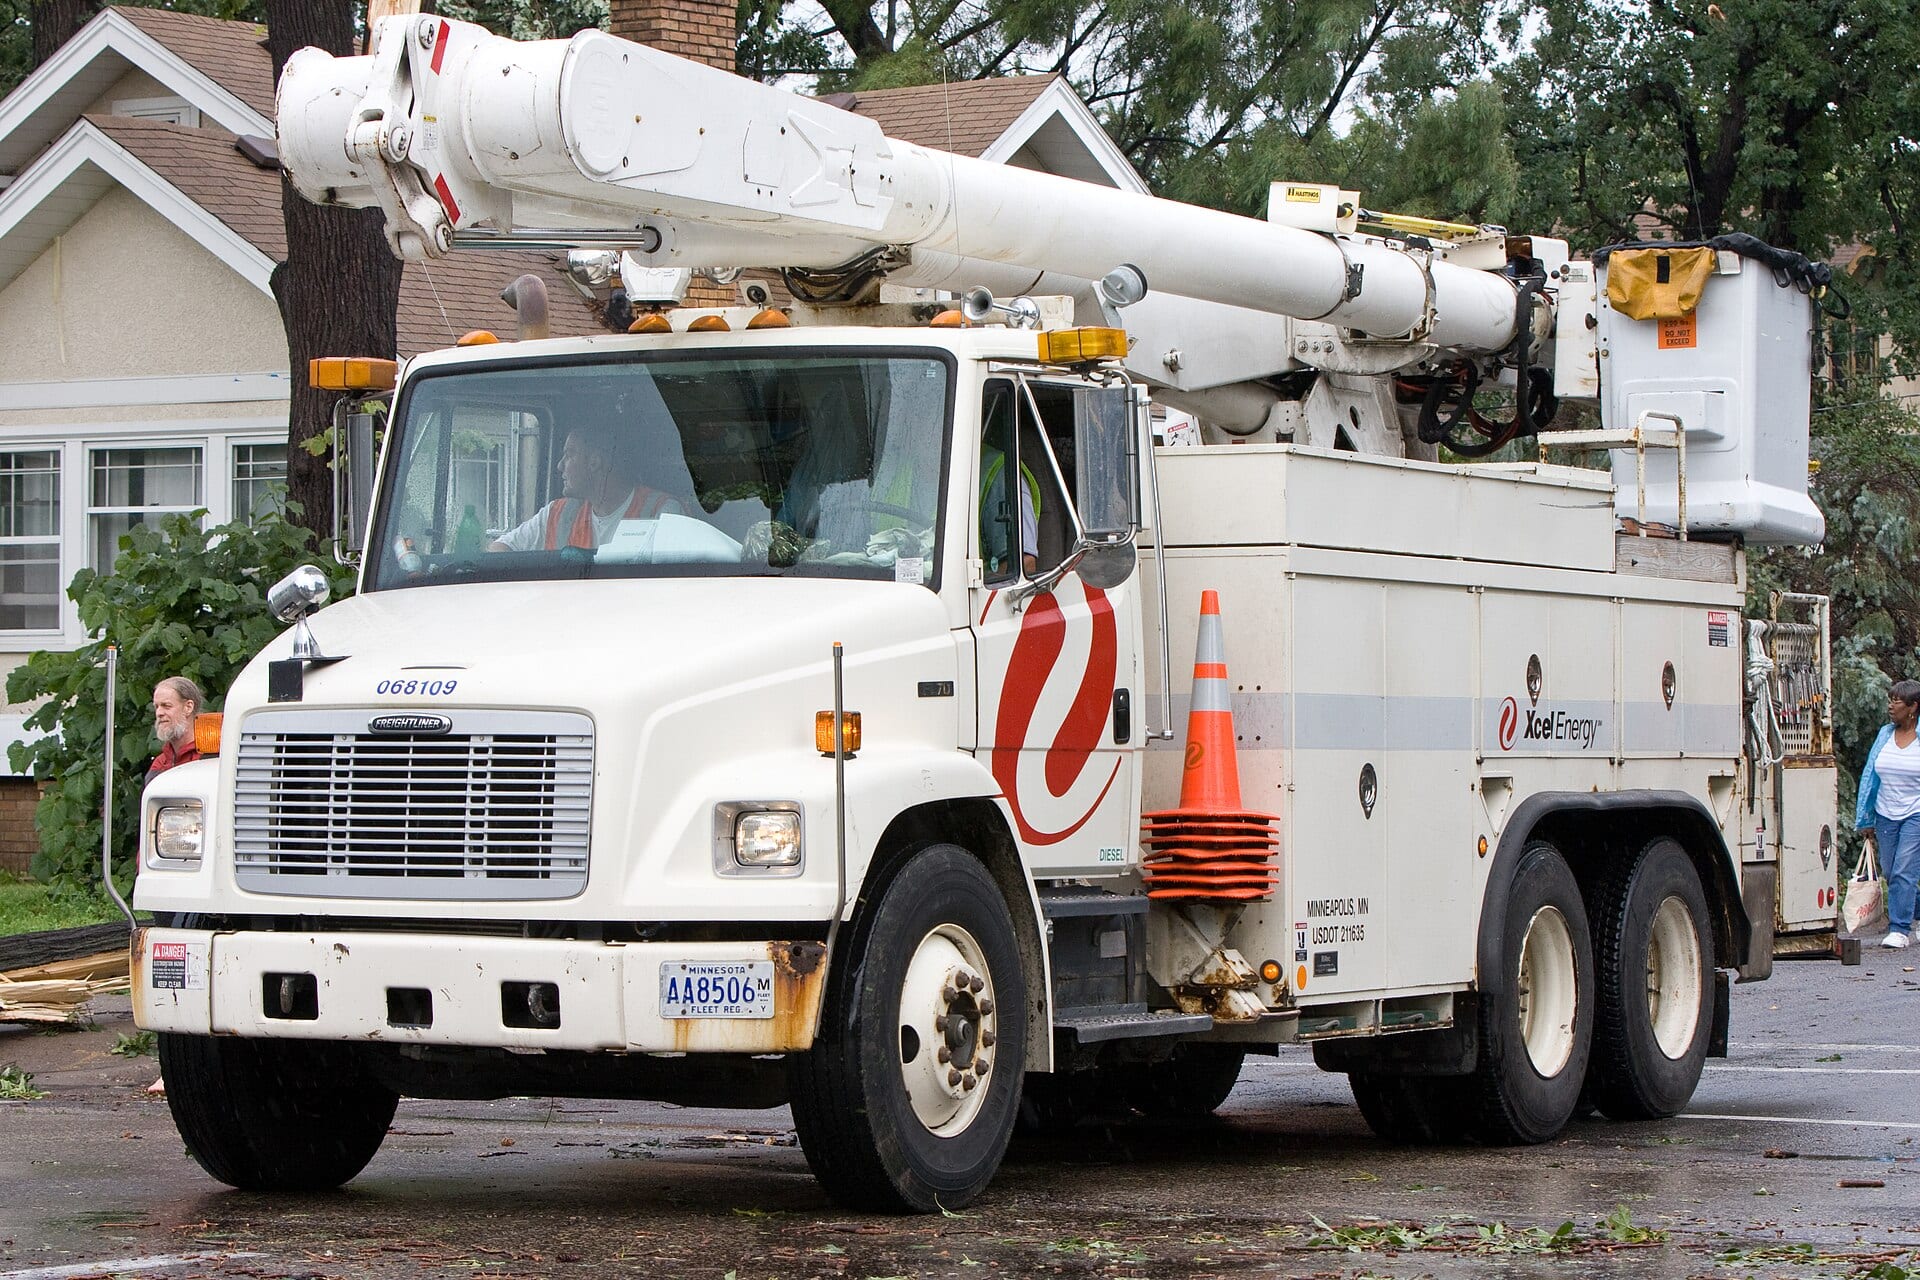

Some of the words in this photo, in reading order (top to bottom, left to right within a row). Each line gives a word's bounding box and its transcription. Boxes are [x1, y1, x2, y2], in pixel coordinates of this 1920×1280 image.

[377, 680, 458, 695] 068109
[375, 718, 441, 729] FREIGHTLINER
[1099, 848, 1124, 861] DIESEL
[1307, 898, 1356, 918] MINNEAPOLIS,
[1358, 898, 1369, 915] MN
[1312, 926, 1339, 944] USDOT
[1340, 925, 1365, 942] 211635
[161, 945, 185, 958] DANGER
[689, 966, 746, 975] MINNESOTA
[667, 976, 756, 1004] AA8506
[757, 978, 770, 991] M
[691, 1005, 719, 1014] FLEET
[760, 1005, 767, 1013] Y
